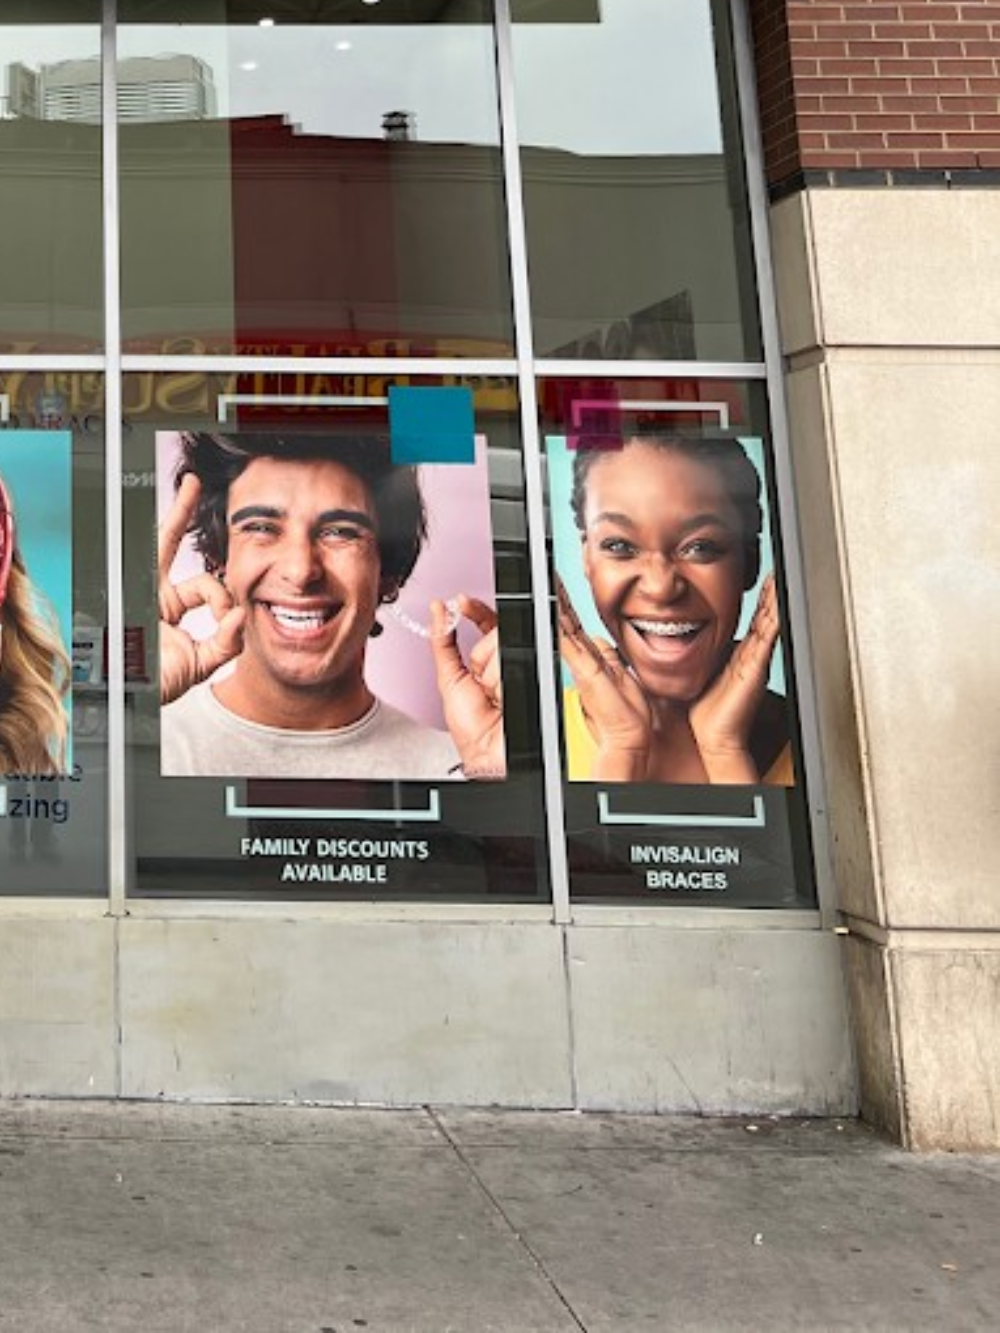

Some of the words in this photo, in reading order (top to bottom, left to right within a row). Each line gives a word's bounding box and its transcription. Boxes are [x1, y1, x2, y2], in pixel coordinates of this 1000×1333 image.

[240, 838, 310, 858] FAMILY
[316, 838, 429, 860] DISCOUNTS
[630, 845, 740, 866] INVISALIGN
[280, 863, 388, 884] AVAILABLE
[646, 870, 728, 891] BRACES
